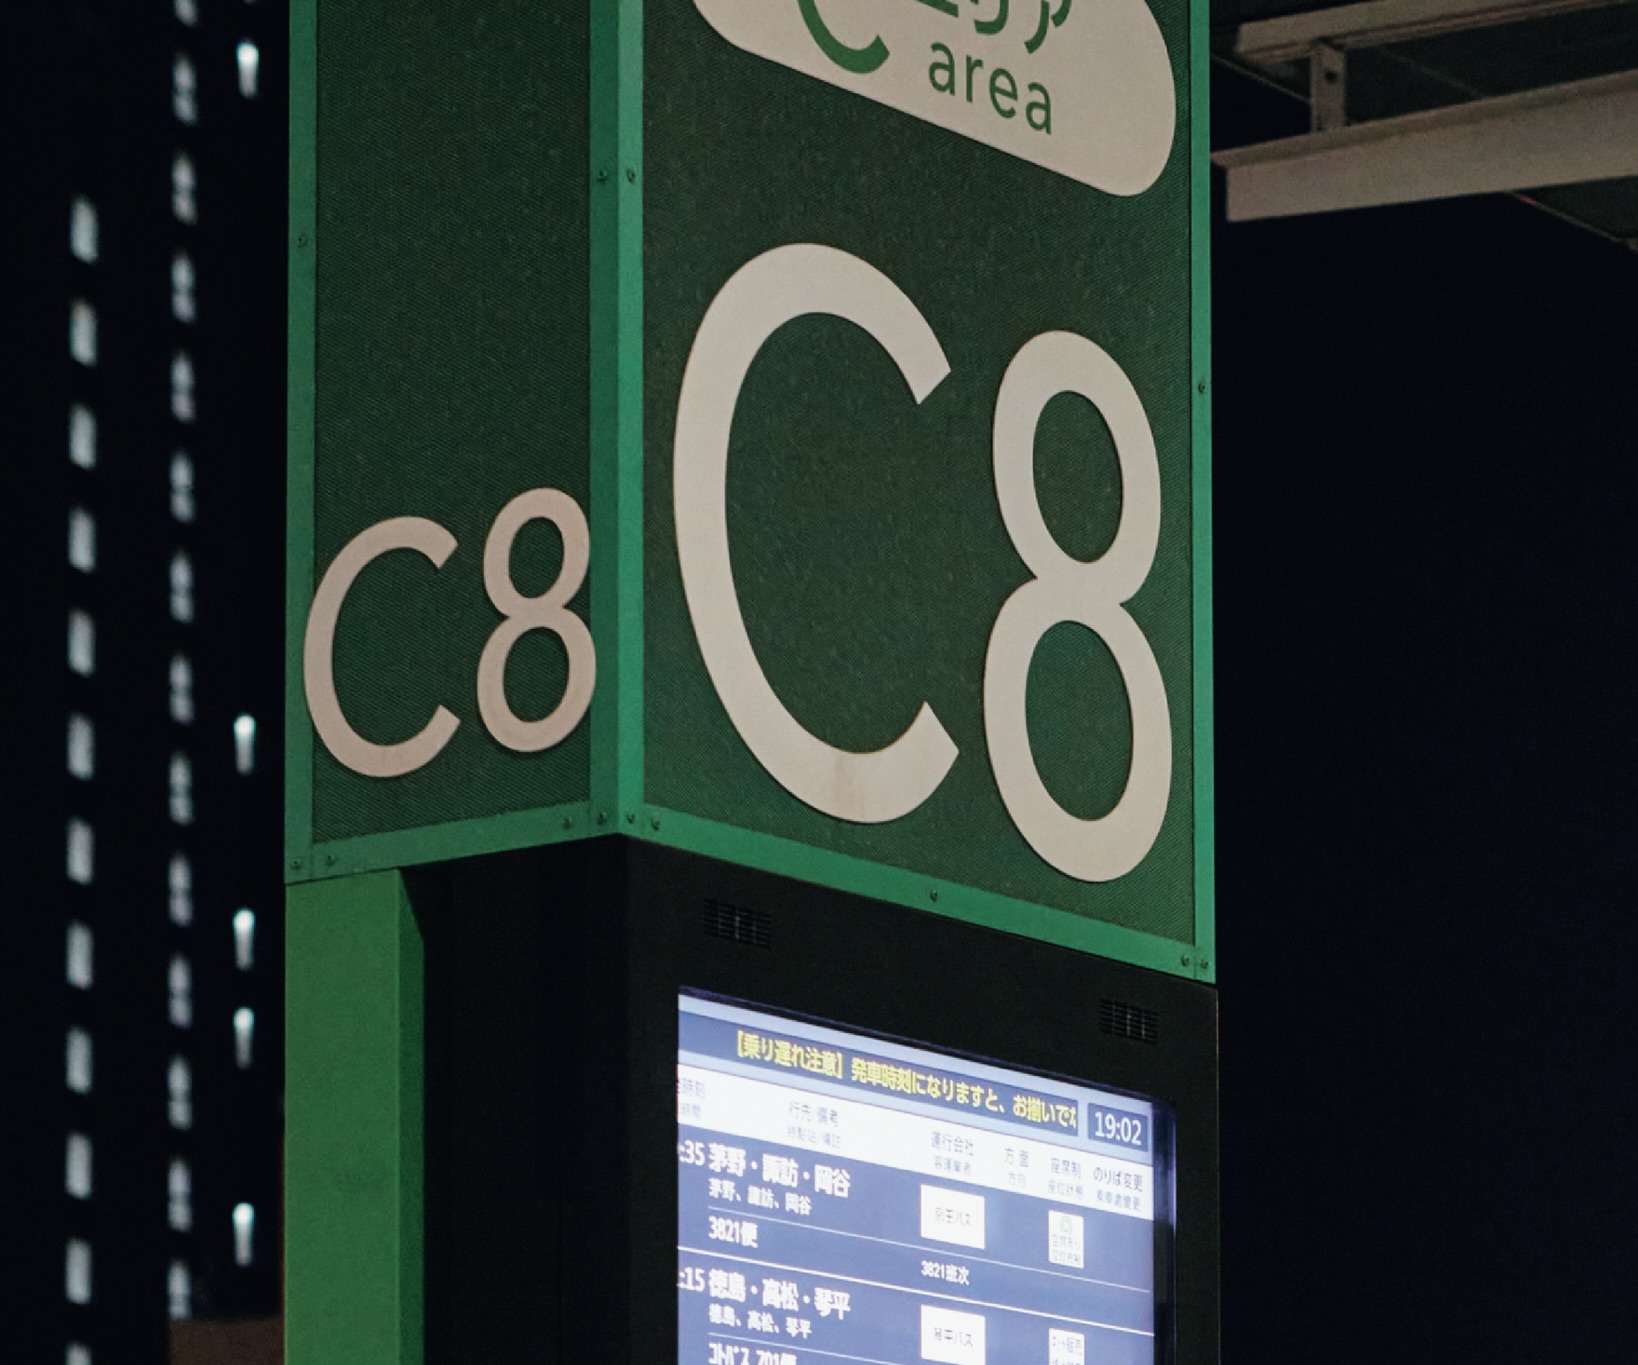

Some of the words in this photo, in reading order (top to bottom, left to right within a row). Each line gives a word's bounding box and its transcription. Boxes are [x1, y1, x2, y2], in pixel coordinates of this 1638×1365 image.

[928, 41, 1052, 135] area
[673, 243, 1172, 882] C8
[303, 487, 596, 778] C8
[1094, 1110, 1142, 1145] 19:02
[1093, 1166, 1144, 1192] のりば変更
[709, 1216, 758, 1248] 3821便
